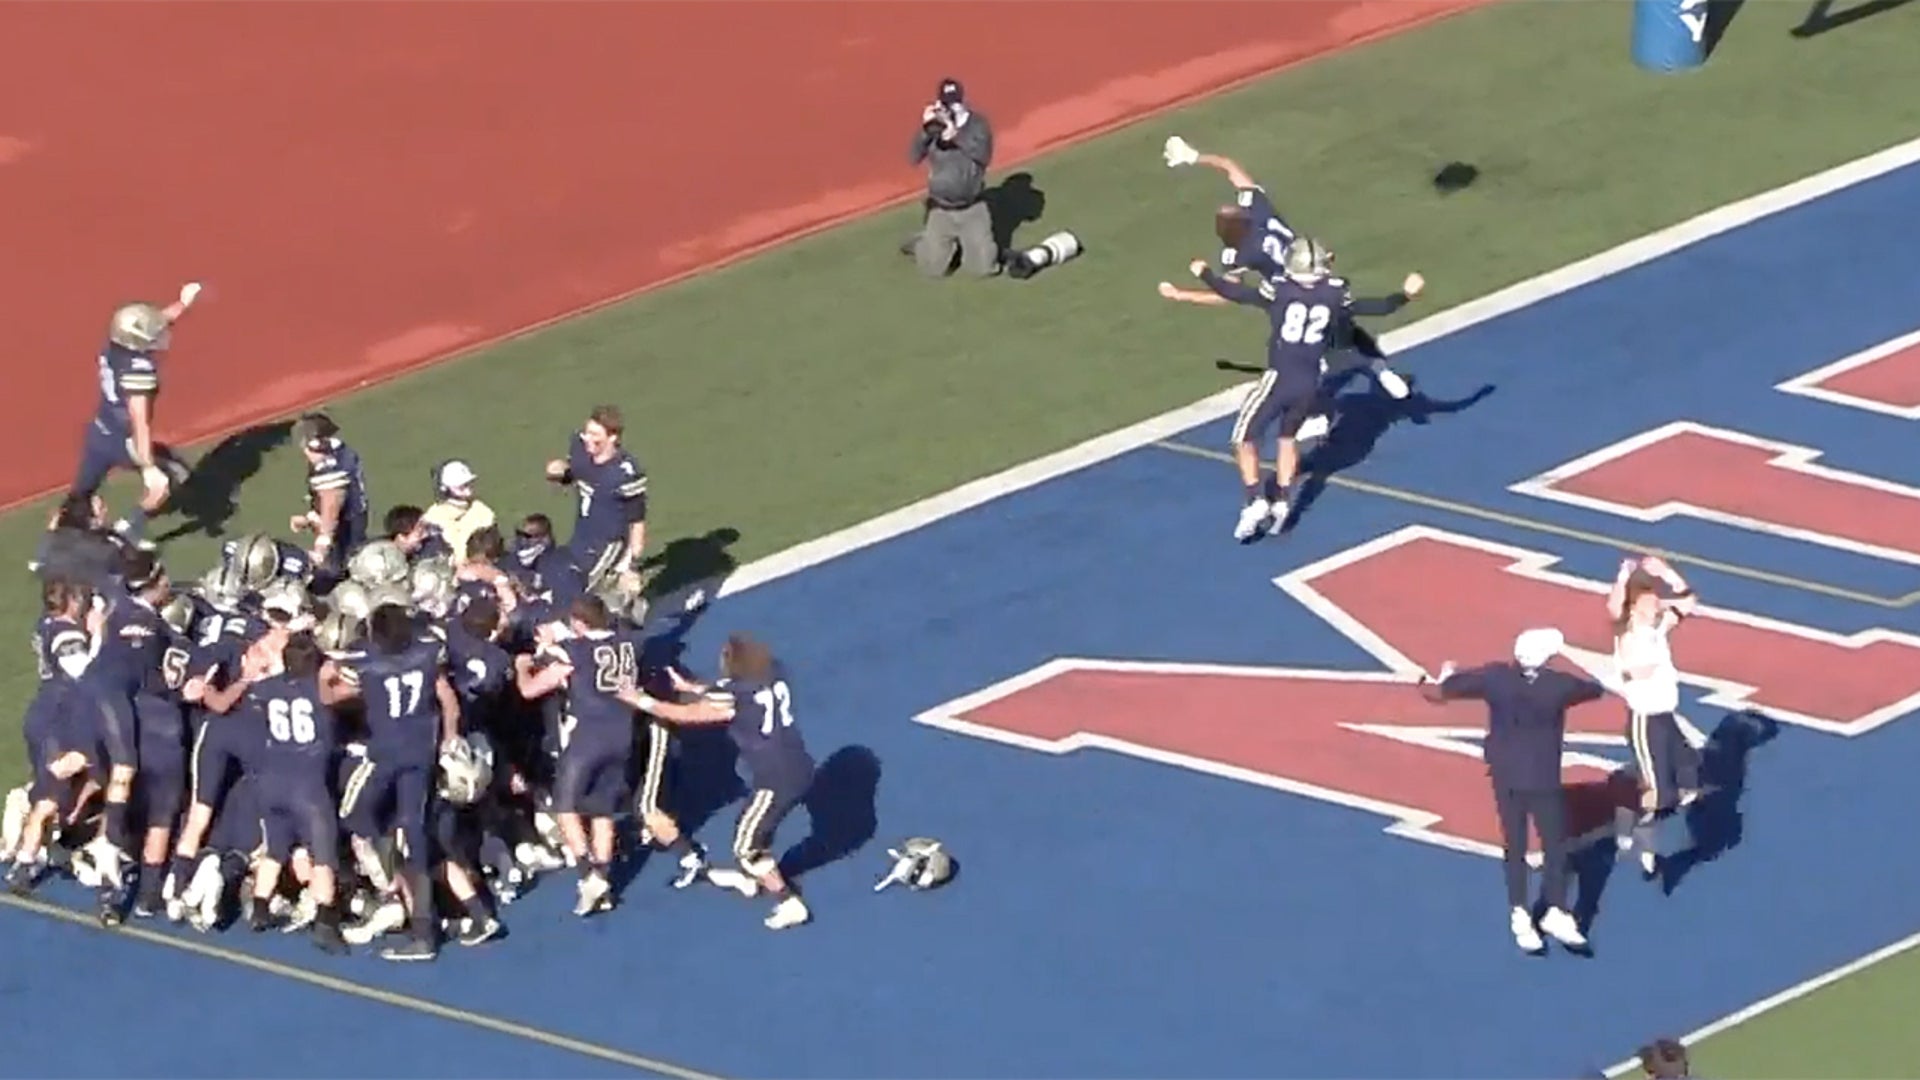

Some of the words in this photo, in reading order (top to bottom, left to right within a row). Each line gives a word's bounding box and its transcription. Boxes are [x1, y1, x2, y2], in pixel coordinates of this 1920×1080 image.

[1281, 301, 1331, 344] 82
[594, 641, 638, 692] 24
[384, 669, 423, 718] 17
[753, 680, 794, 735] 72
[268, 697, 316, 744] 66
